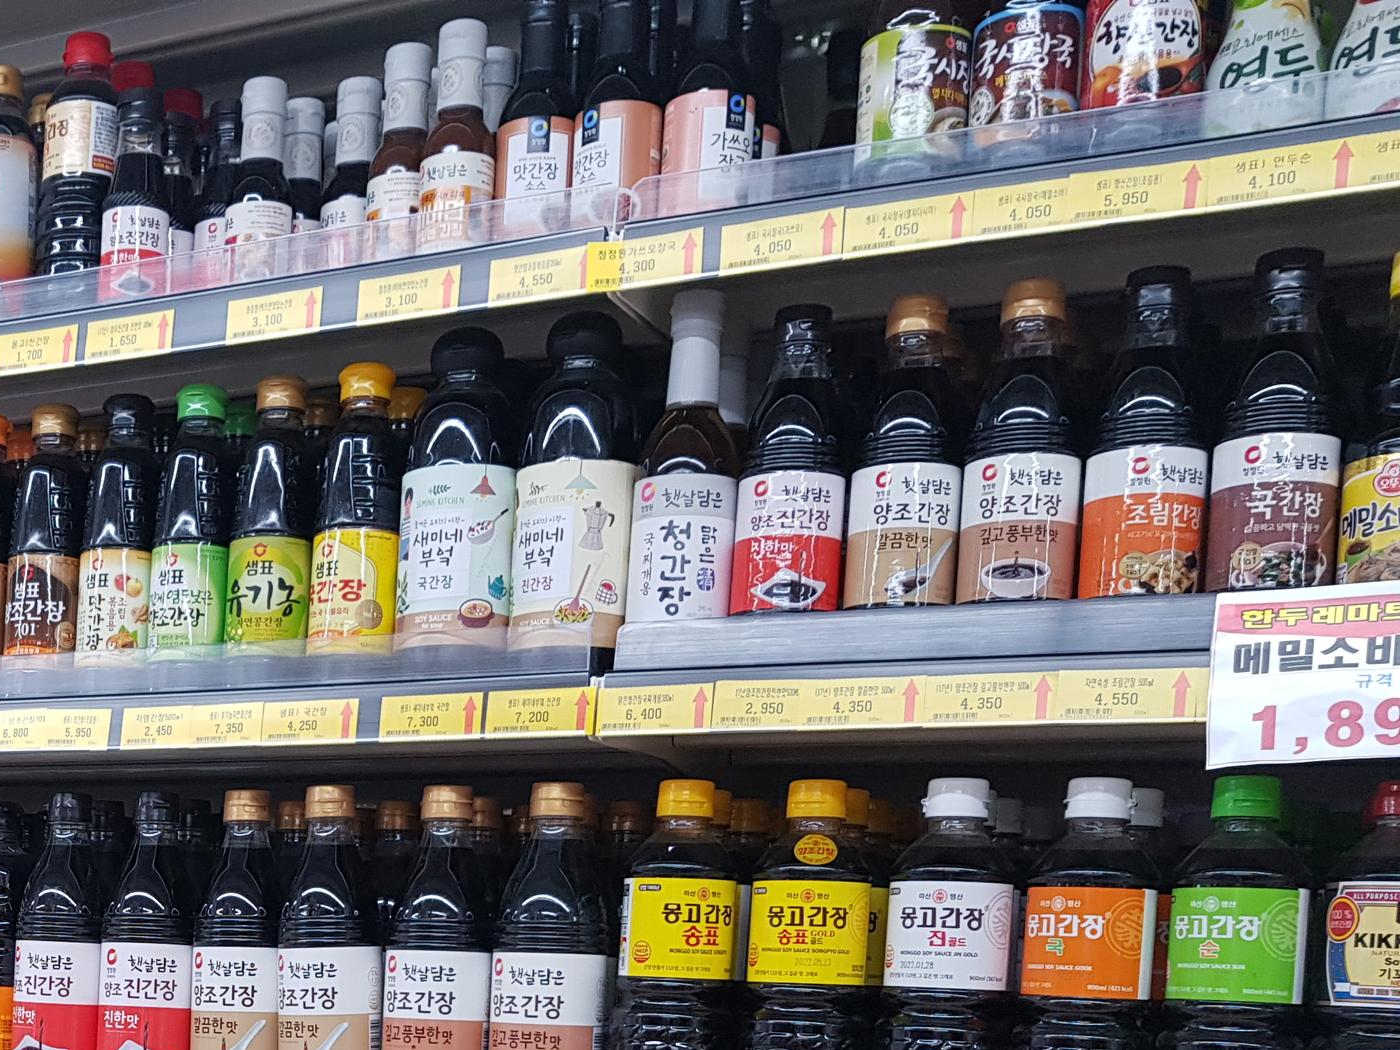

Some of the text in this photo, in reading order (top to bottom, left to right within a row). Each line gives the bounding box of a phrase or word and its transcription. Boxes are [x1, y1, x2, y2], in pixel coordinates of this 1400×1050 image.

[513, 164, 559, 182] 맛간장
[1248, 171, 1296, 189] 4,100
[1103, 190, 1148, 208] 5,950
[1009, 204, 1052, 222] 4,050
[879, 221, 919, 240] 4,050
[753, 239, 792, 257] 4,050
[619, 258, 655, 275] 4,300
[518, 272, 553, 289] 4,550
[385, 292, 418, 309] 3,100
[252, 313, 282, 327] 3,100
[16, 348, 42, 363] 1,700
[1009, 468, 1063, 487] 햇살담은
[660, 488, 723, 510] 햇살담은
[979, 492, 1063, 518] 양조간장
[1246, 489, 1323, 519] 국간장
[872, 502, 951, 526] 양조간장
[412, 527, 463, 548] 새미네
[518, 527, 565, 548] 새미네
[418, 545, 455, 568] 부엌
[523, 545, 555, 567] 부엌
[245, 558, 275, 575] 샘표
[417, 574, 454, 591] 국간장
[520, 574, 554, 593] 진간장
[1355, 672, 1392, 689] 규격
[745, 702, 784, 715] 2,950
[833, 700, 873, 714] 4,350
[960, 696, 1002, 710] 4,350
[1095, 693, 1139, 707] 4,550
[407, 715, 439, 728] 7,300
[515, 710, 549, 724] 7,200
[625, 707, 662, 721] 6,400
[2, 727, 29, 739] 6,800
[144, 724, 173, 737] 2,450
[214, 721, 244, 734] 7,350
[287, 718, 318, 732] 4,250
[661, 902, 733, 927] 몽고간장
[767, 906, 849, 929] 몽고간장
[900, 907, 984, 930] 몽고간장
[1027, 914, 1104, 940] 몽고간장
[1174, 914, 1261, 940] 몽고간장
[682, 925, 720, 948] 송표
[777, 928, 809, 945] 송표
[1046, 938, 1064, 956] 국
[127, 954, 178, 973] 햇살담은
[207, 958, 258, 977] 햇살담은
[402, 963, 457, 983] 햇살담은
[509, 968, 566, 986] 햇살담은
[194, 985, 257, 1007] 양조간장
[386, 990, 456, 1015] 양조간장
